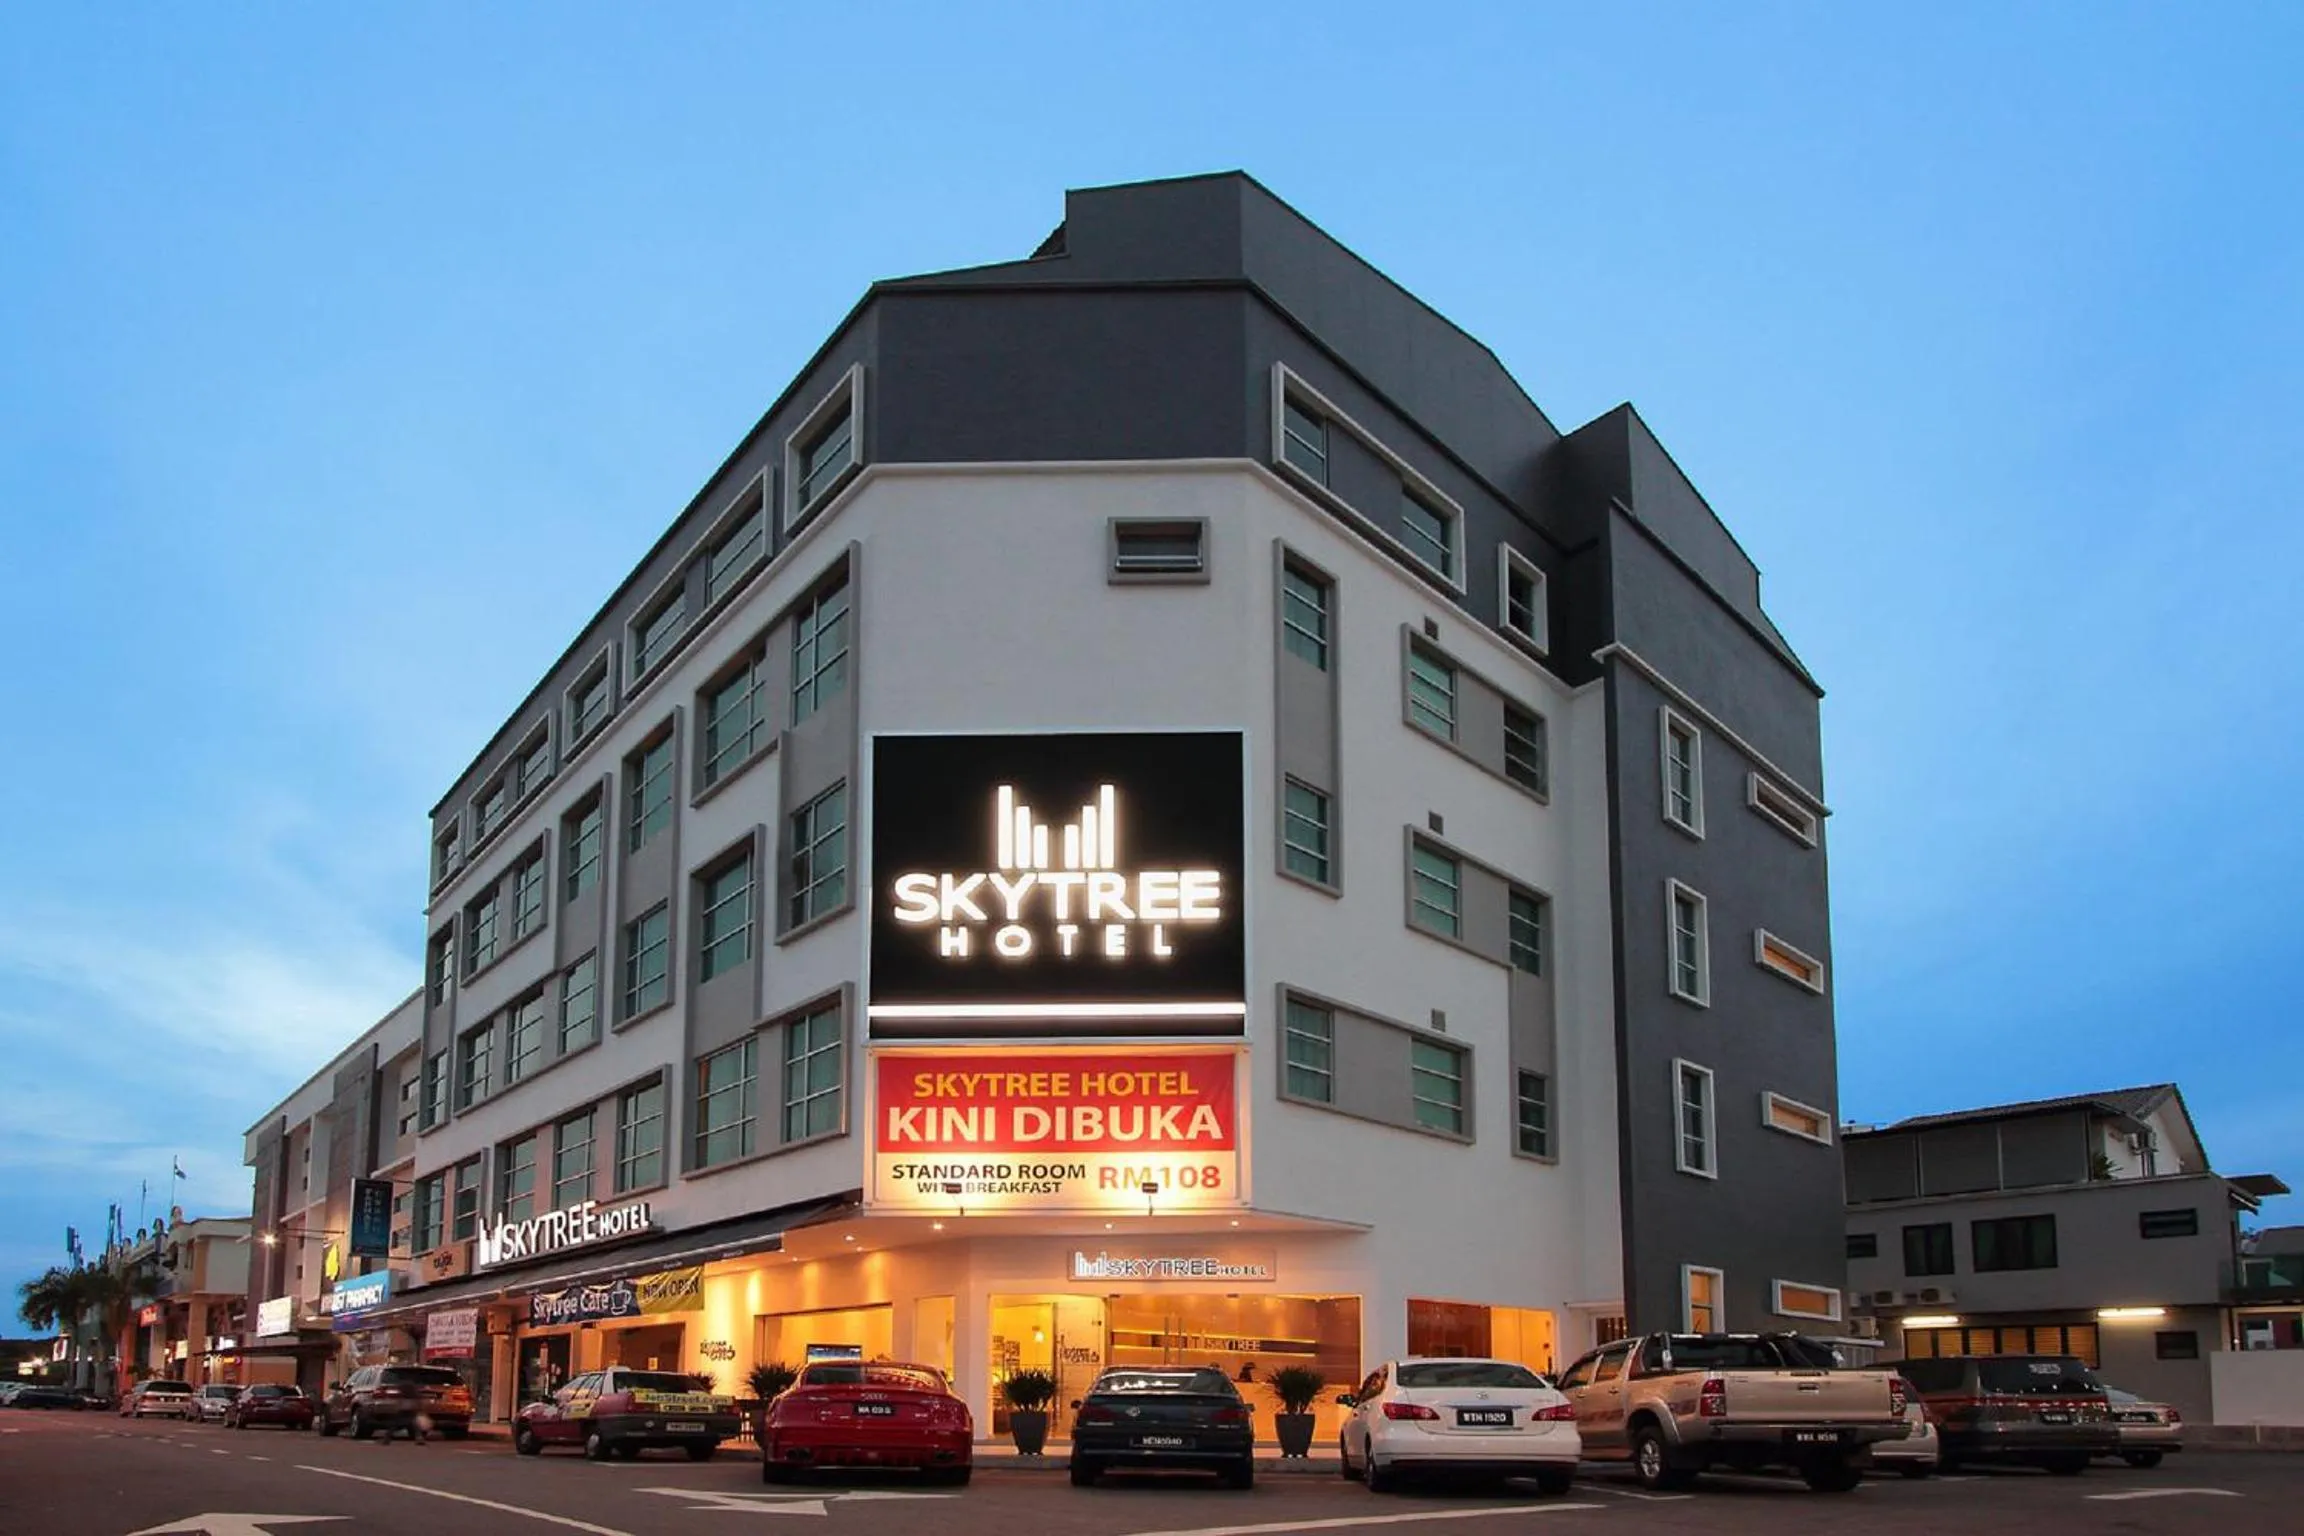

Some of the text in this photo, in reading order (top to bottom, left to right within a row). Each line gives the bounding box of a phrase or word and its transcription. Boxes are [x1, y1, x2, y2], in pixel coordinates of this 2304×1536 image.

[893, 870, 1221, 922] SKYTREE
[939, 924, 1172, 957] HOTEL
[914, 1071, 1200, 1098] SKYTREE HOTEL
[888, 1104, 1224, 1143] KINI DIBUKA
[892, 1163, 1086, 1180] STANDARD ROOM
[917, 1181, 1062, 1194] WIT BREAKFAST
[502, 1200, 649, 1260] SKYTREE HOTEL
[1106, 1257, 1266, 1276] SKYTREE HOTEL
